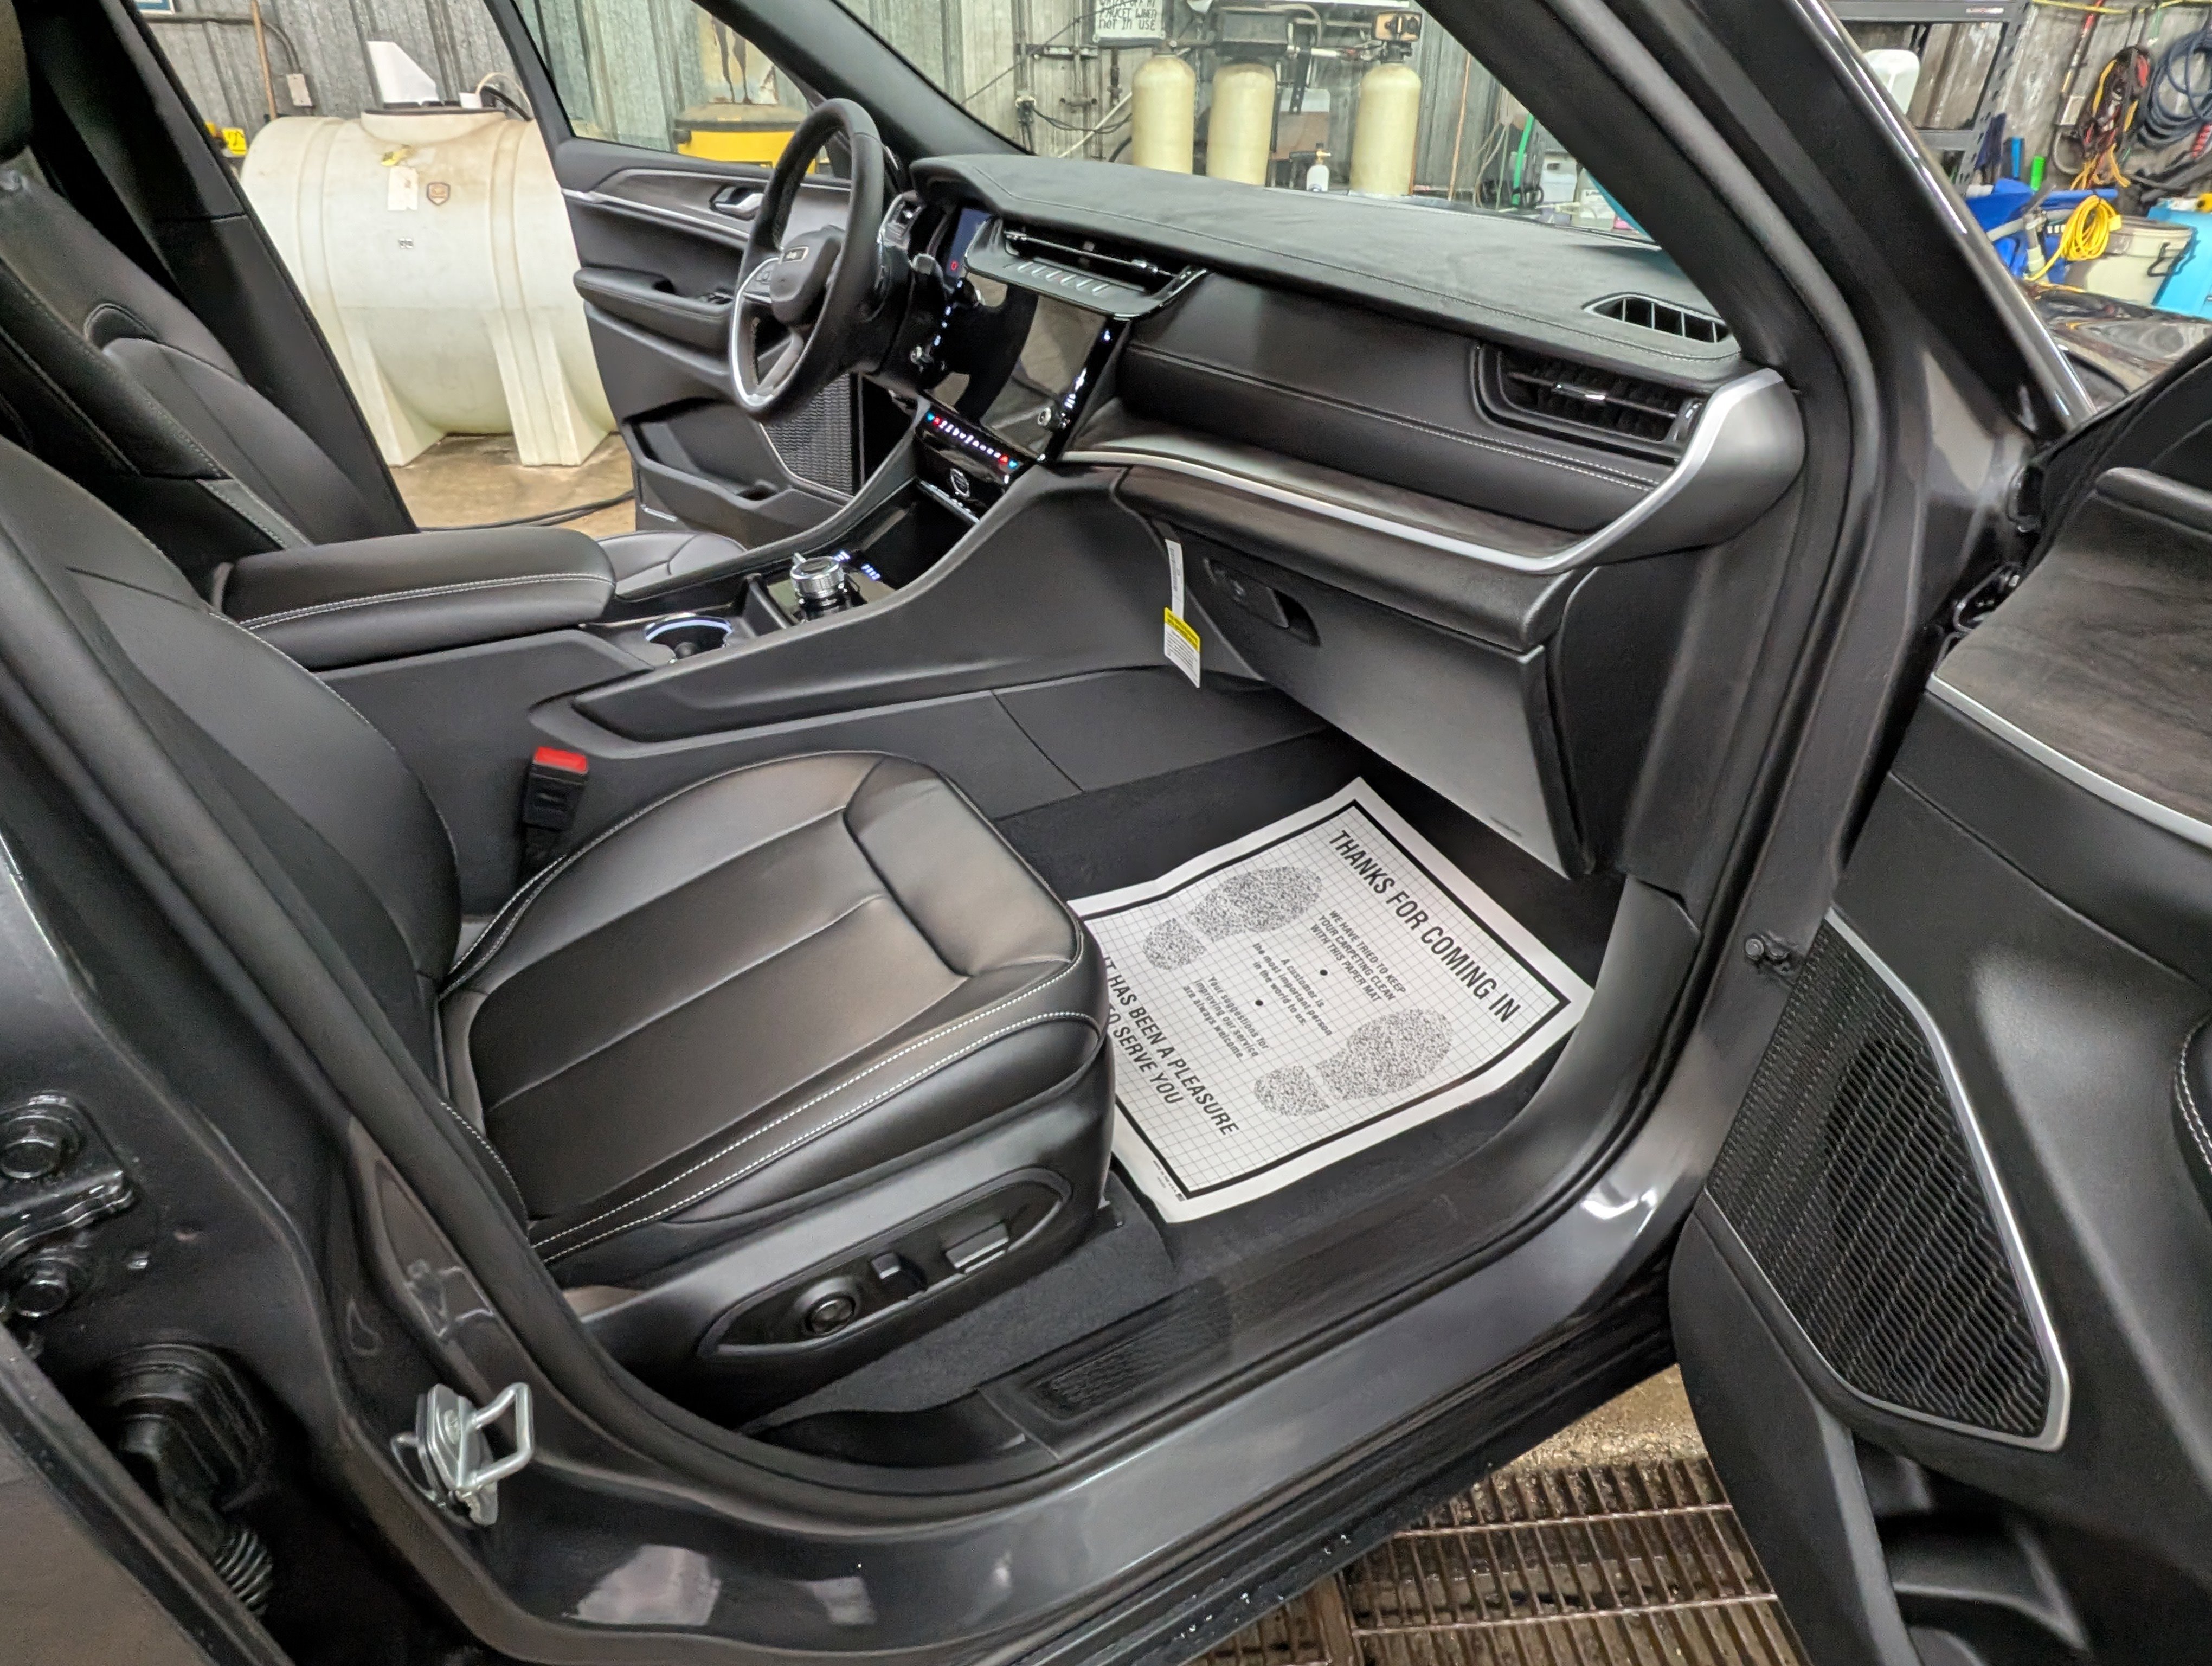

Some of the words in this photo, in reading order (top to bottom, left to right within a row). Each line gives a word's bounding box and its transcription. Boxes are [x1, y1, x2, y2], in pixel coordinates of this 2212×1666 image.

[1310, 924, 1331, 944] WITH
[1327, 943, 1345, 962] THIS
[1341, 961, 1366, 986] PAPER
[1362, 985, 1381, 1002] MAT
[1319, 915, 1339, 936] YOUR
[1335, 935, 1374, 976] CARPETING
[1371, 975, 1396, 1001] CLEAN
[1329, 830, 1395, 894] THANKS
[1386, 890, 1429, 930] FOR
[1421, 926, 1497, 999] COMING
[1489, 993, 1521, 1023] IN
[1329, 910, 1343, 923] WE
[1339, 922, 1360, 942] HAVE
[1356, 941, 1379, 963] TRIED
[1376, 963, 1388, 974] TO
[1385, 974, 1406, 993] KEEP
[1183, 985, 1196, 999] are
[1193, 999, 1217, 1025] always
[1194, 979, 1225, 1016] improving
[1223, 1016, 1237, 1029] our
[1233, 1030, 1259, 1057] service
[1208, 976, 1224, 994] Your
[1221, 994, 1259, 1037] suggestions
[1256, 1037, 1269, 1049] for
[1253, 961, 1262, 970] in
[1259, 970, 1272, 983] the
[1270, 983, 1291, 1004] world
[1288, 1004, 1297, 1013] to
[1253, 943, 1265, 954] the
[1263, 956, 1281, 973] most
[1278, 973, 1311, 1009] important
[1306, 1010, 1332, 1036] person
[1287, 965, 1317, 998] customer
[1315, 999, 1324, 1008] is
[1108, 974, 1137, 1006] HAS
[1128, 1006, 1167, 1045] BEEN
[1156, 1046, 1175, 1059] A
[1167, 1058, 1239, 1135] PLEASURE
[1113, 1026, 1158, 1072] SERVE
[1150, 1072, 1184, 1104] YOU
